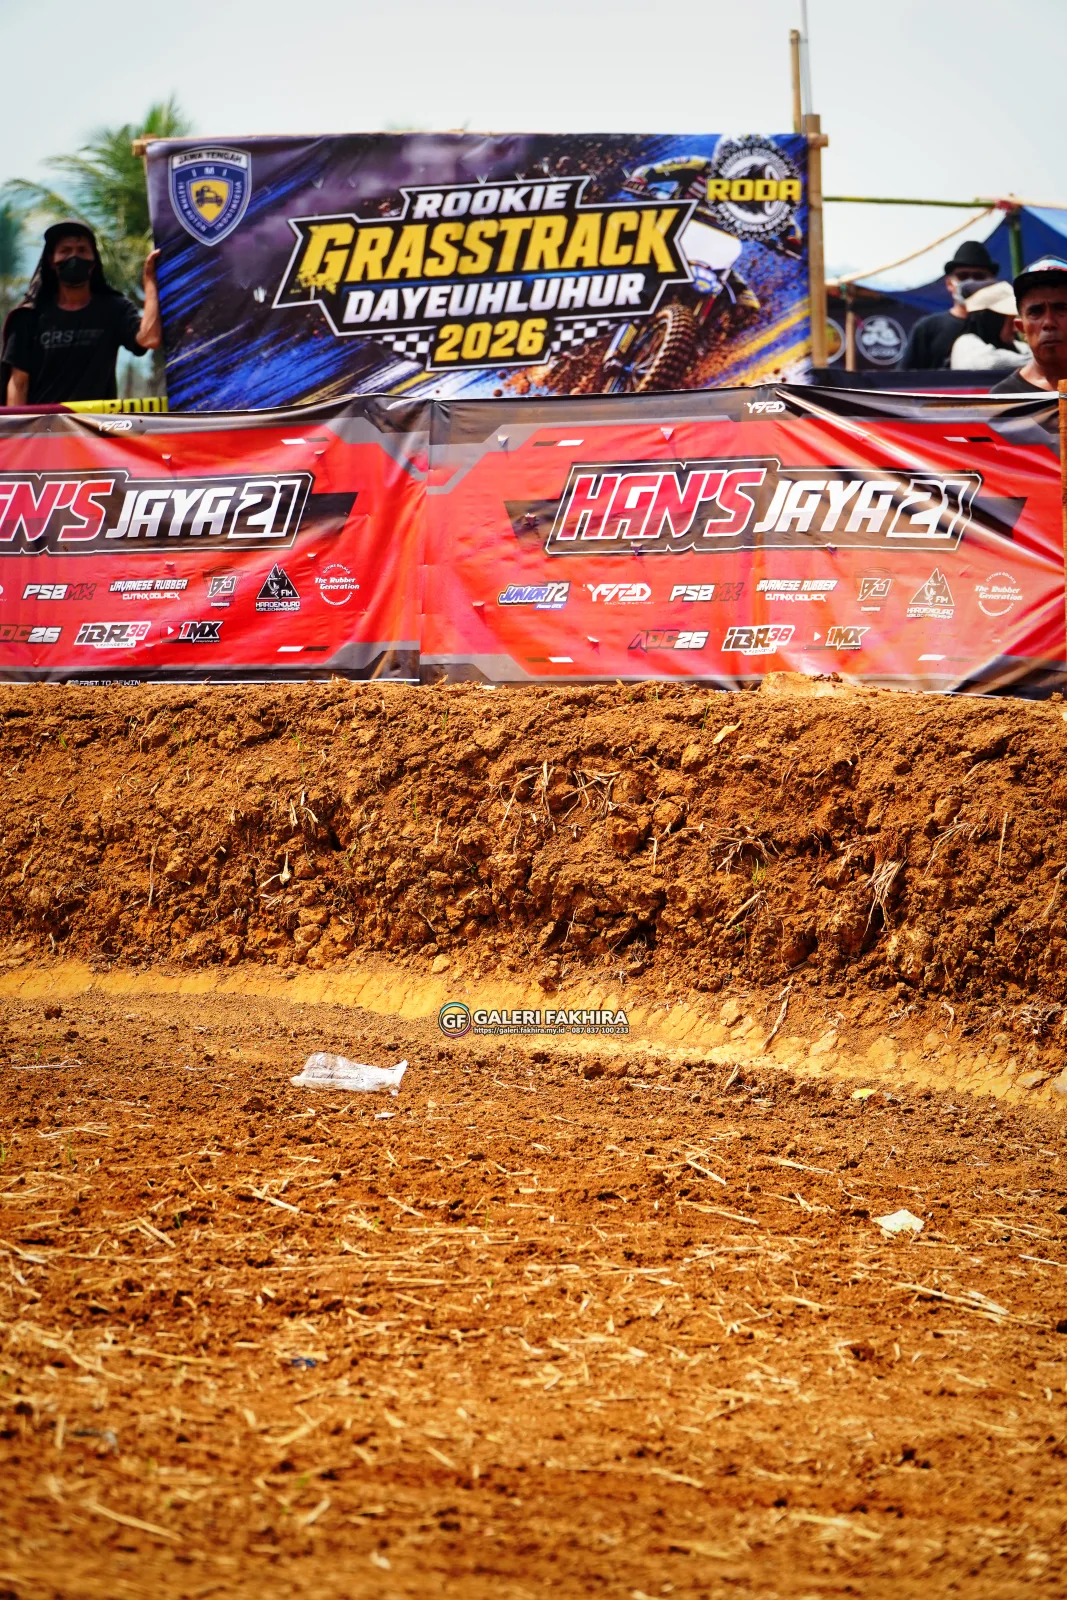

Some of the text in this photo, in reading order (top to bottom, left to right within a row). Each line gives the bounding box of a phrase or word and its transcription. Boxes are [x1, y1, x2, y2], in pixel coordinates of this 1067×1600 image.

[179, 151, 242, 164] JAWA TENGAH
[412, 182, 571, 219] ROOKIE
[707, 178, 802, 202] RODA
[294, 207, 680, 293] GRASSTRACK
[342, 272, 646, 324] DAYEUHLUHUR
[433, 318, 549, 362] 2026
[0, 479, 115, 542] N'S
[109, 579, 188, 592] JAVANESE RUBBER
[756, 580, 838, 592] JAVANESE RUBBER
[979, 592, 1023, 601] Generation
[991, 586, 1021, 594] Rubber
